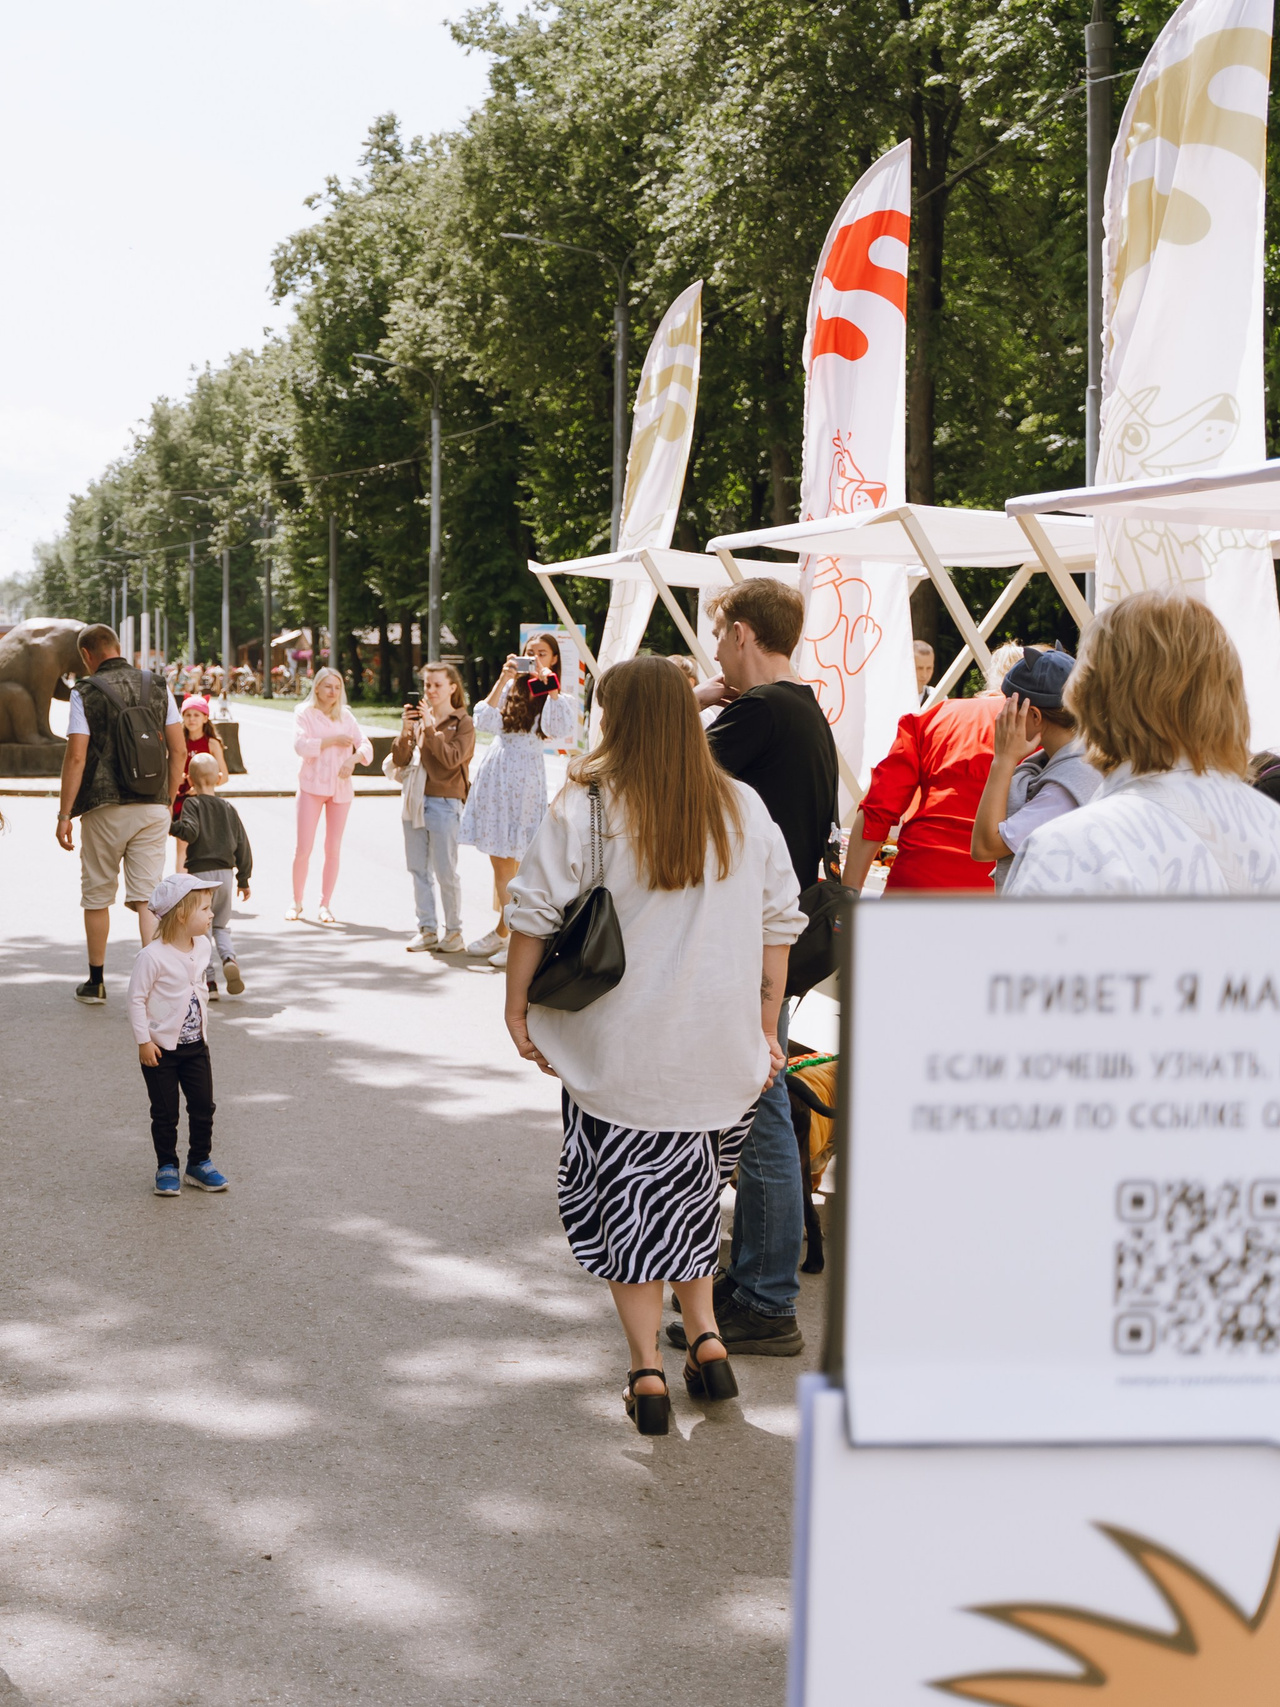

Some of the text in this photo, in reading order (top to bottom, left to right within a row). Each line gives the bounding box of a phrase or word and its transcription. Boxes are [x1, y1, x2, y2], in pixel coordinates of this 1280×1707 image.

[1176, 971, 1201, 1014] Я
[925, 1052, 1005, 1083] ЕСЛИ
[1018, 1051, 1136, 1082] ХОЧЕШЬ
[911, 1103, 1064, 1132] ПЕРЕХОДИ
[1075, 1102, 1117, 1130] ПО
[1128, 1101, 1246, 1129] ССЫЛКЕ
